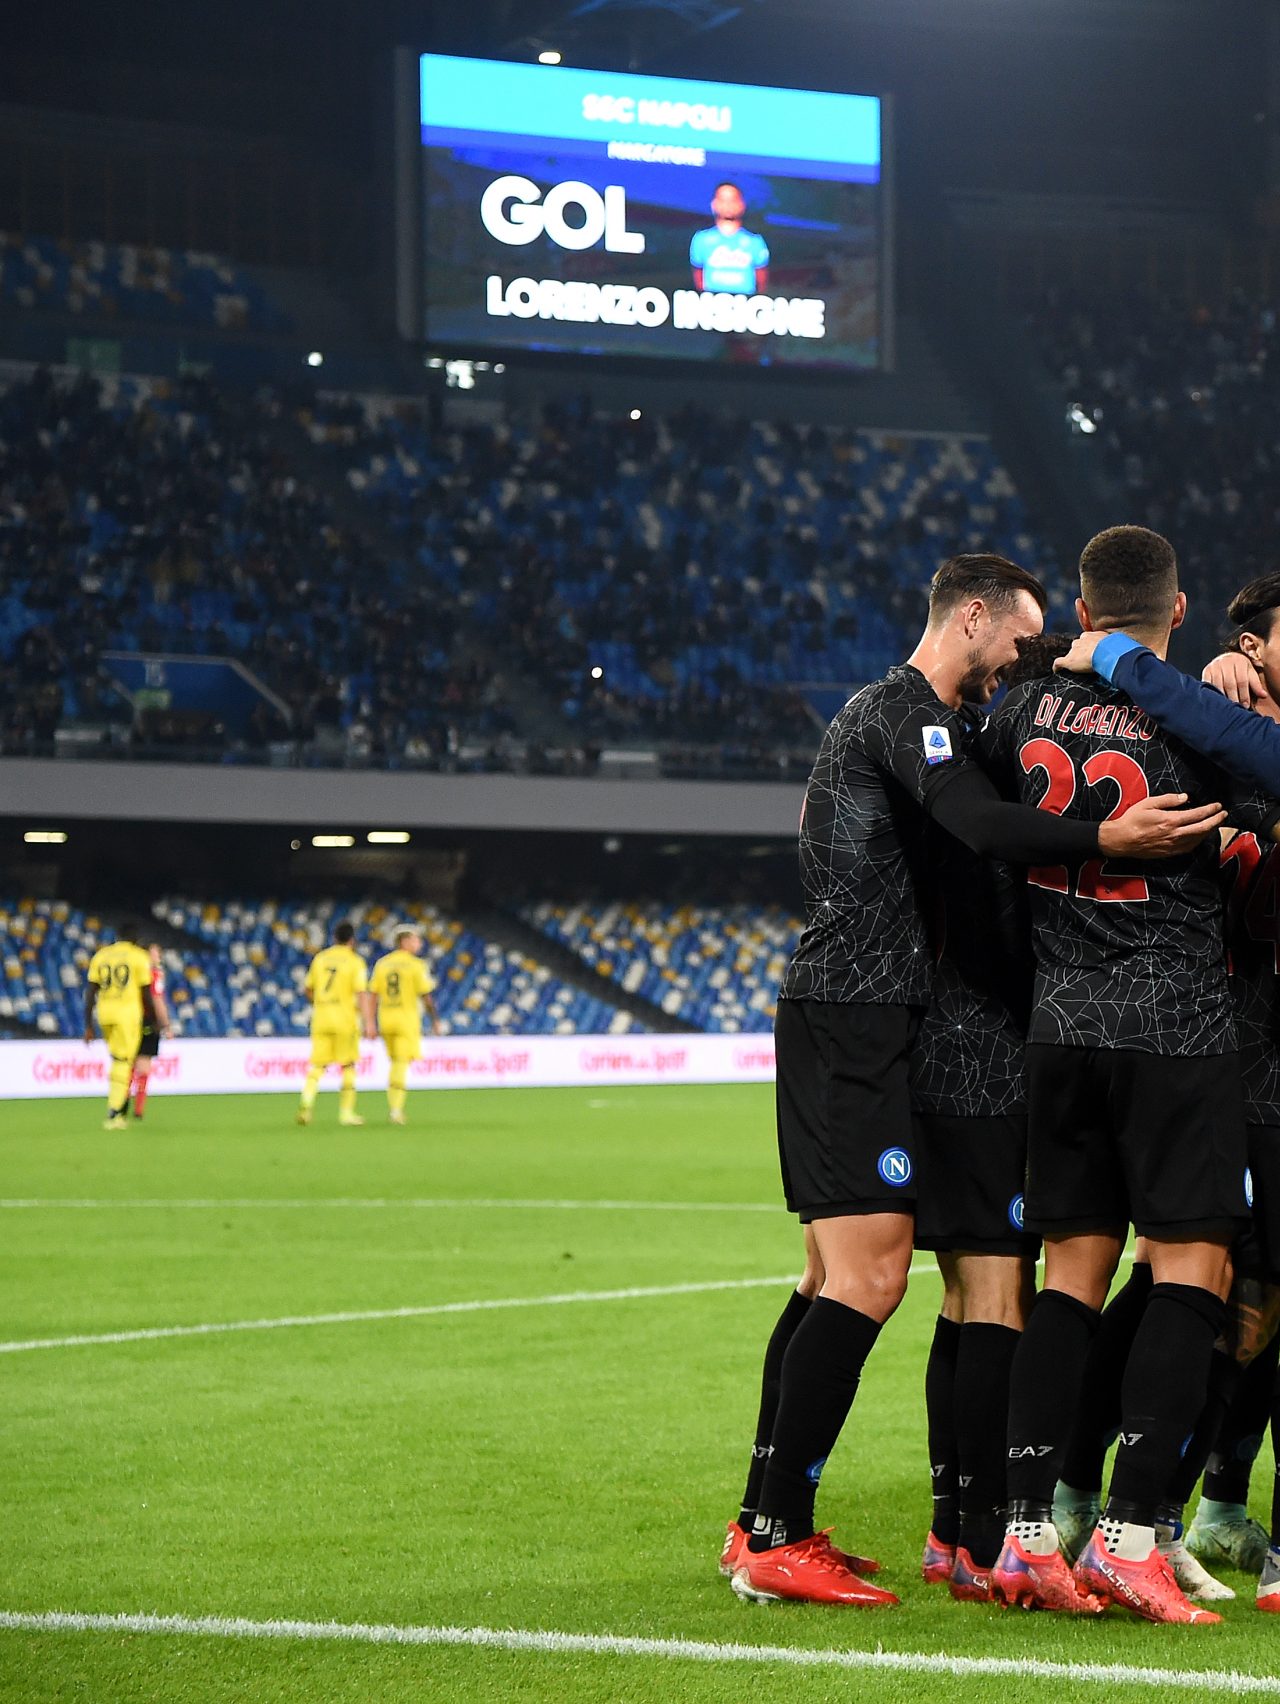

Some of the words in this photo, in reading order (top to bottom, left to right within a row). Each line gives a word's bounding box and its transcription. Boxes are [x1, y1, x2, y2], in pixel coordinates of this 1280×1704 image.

[582, 94, 634, 123] SSC
[638, 99, 732, 132] NAPOLI
[480, 175, 645, 254] GOL
[486, 275, 670, 327] LORENZO
[673, 289, 826, 338] INSIGNE
[1034, 693, 1062, 728] DI
[1057, 701, 1158, 741] LORENZO
[1019, 737, 1150, 902] 22
[97, 963, 130, 991] 99
[325, 967, 337, 993] 7
[386, 972, 399, 998] 8
[889, 1157, 906, 1177] N
[1008, 1446, 1054, 1458] EA7
[1118, 1432, 1144, 1446] A7
